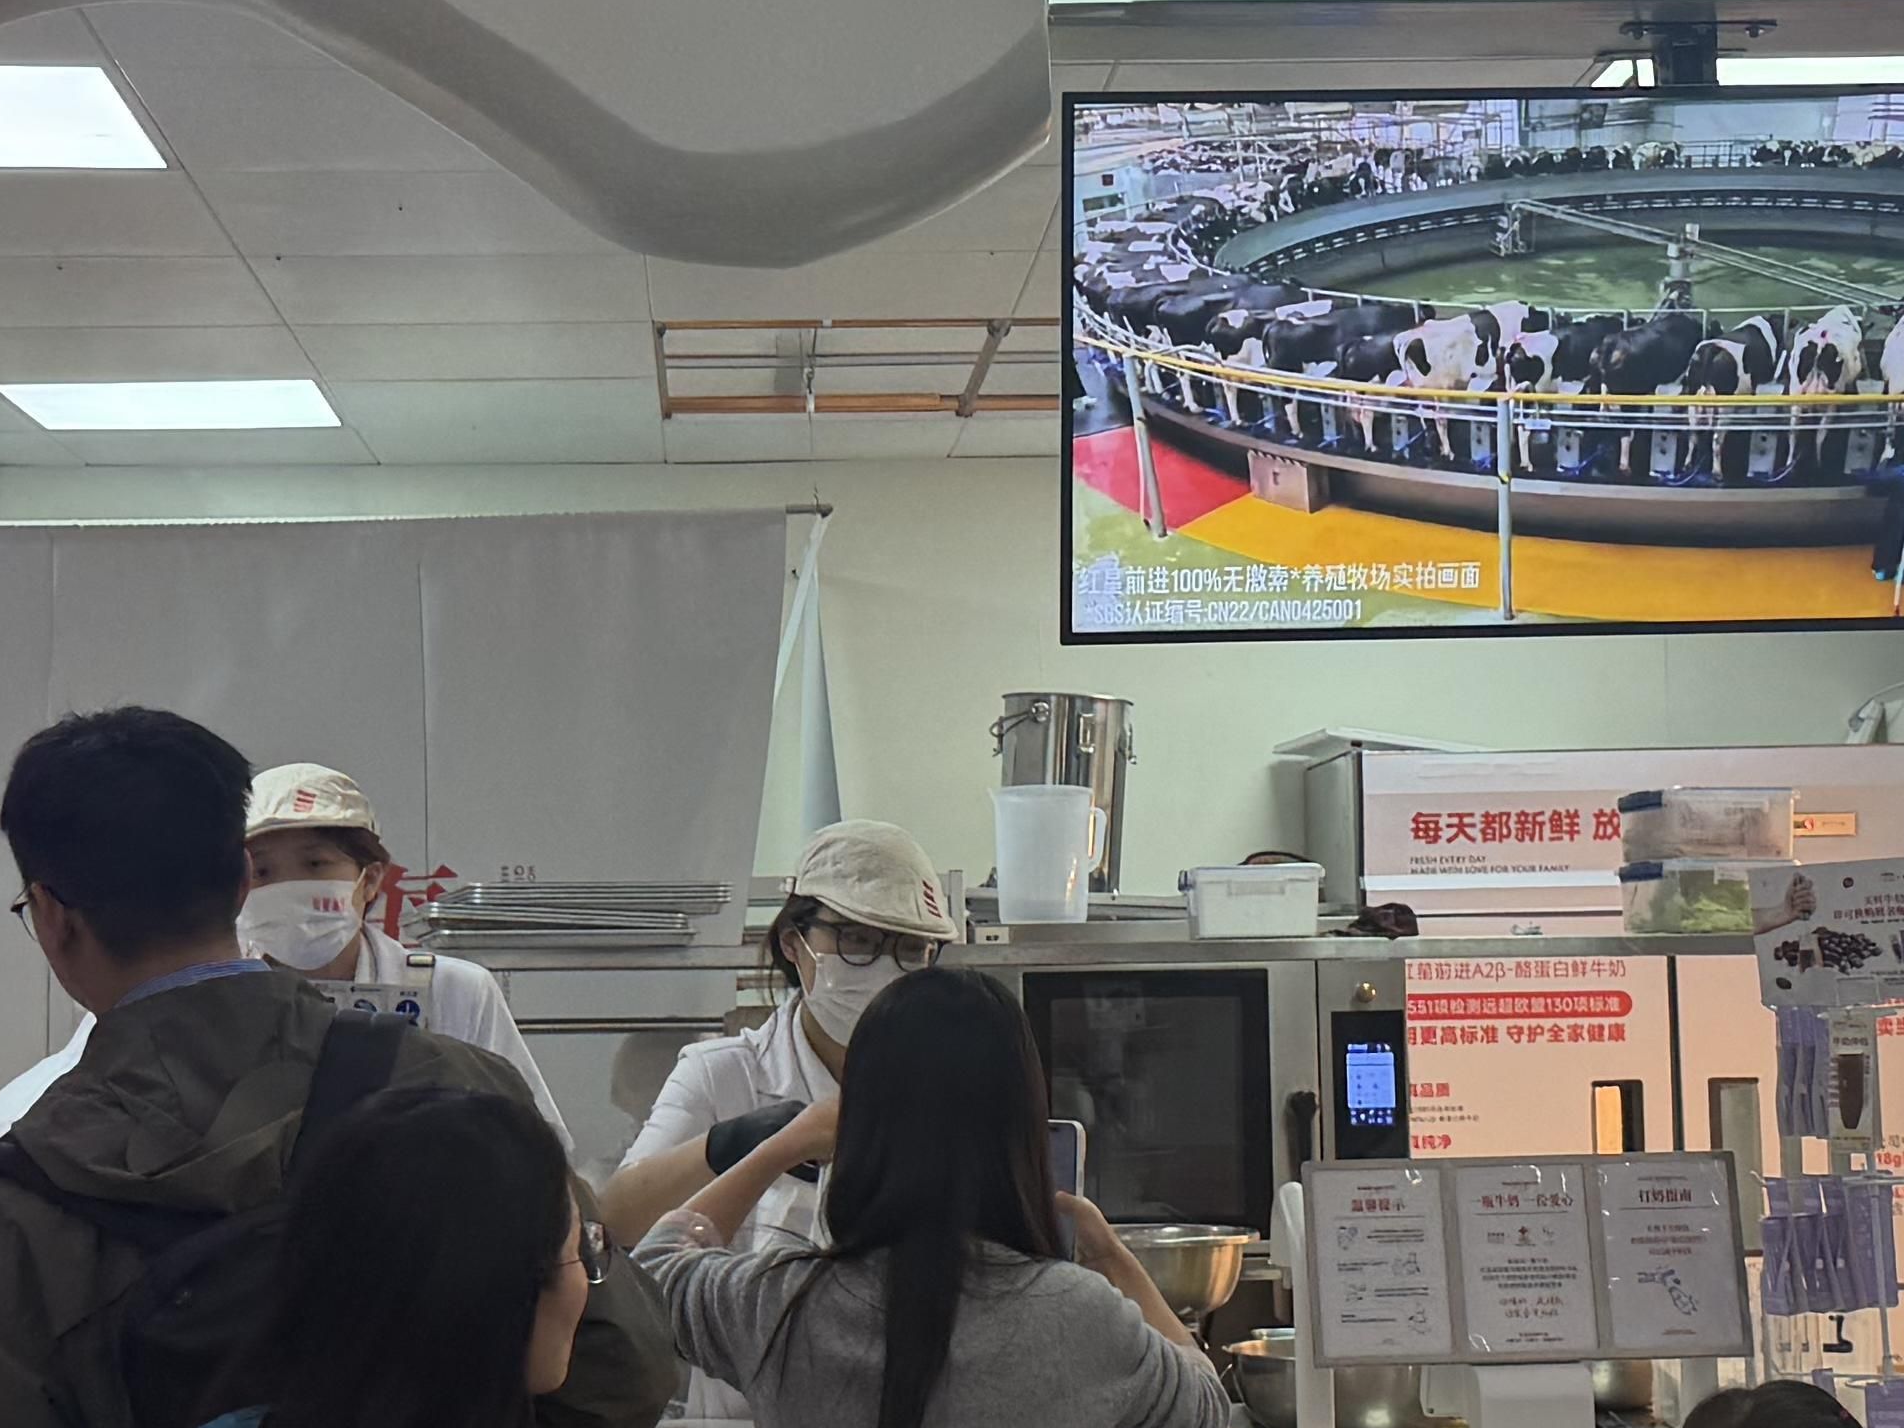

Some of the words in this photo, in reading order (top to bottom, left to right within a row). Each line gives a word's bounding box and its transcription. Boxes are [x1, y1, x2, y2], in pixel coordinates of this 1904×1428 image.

[1411, 810, 1581, 845] 每天都新鲜
[1593, 809, 1621, 840] 放
[1440, 856, 1466, 864] EVERY
[1507, 1023, 1626, 1044] 守护全家健康
